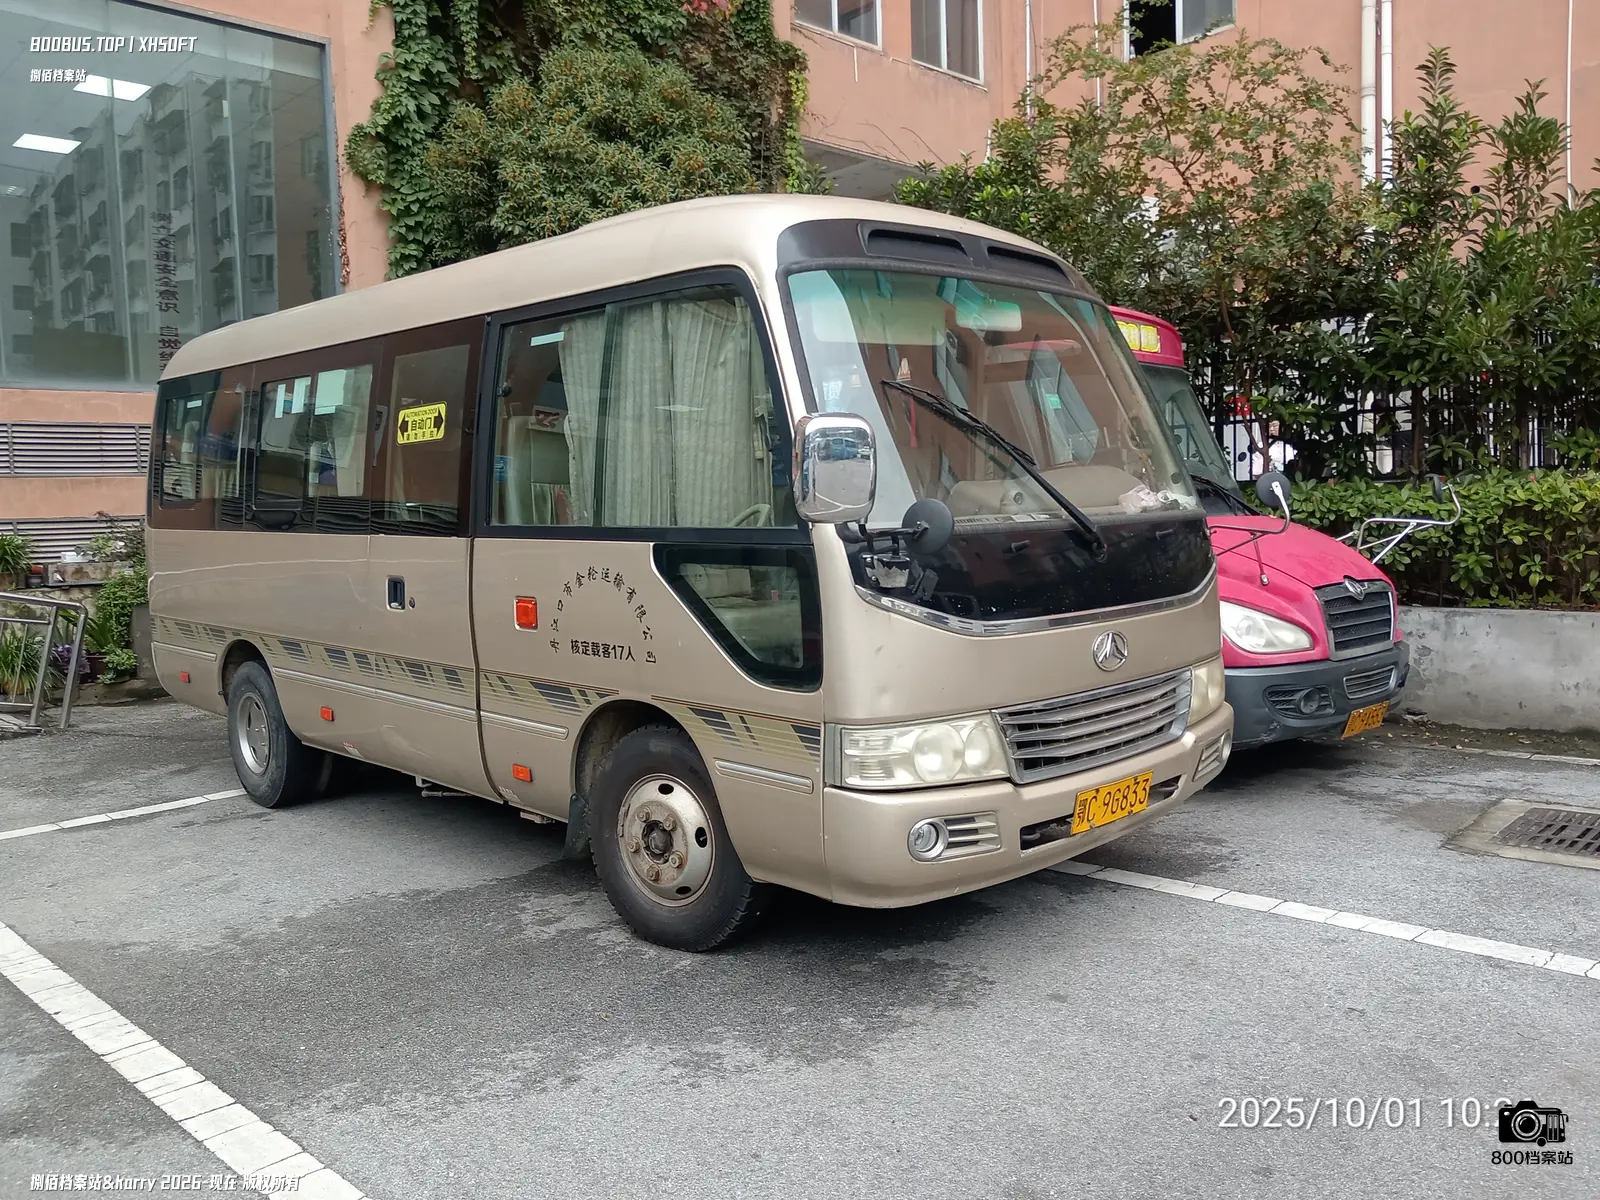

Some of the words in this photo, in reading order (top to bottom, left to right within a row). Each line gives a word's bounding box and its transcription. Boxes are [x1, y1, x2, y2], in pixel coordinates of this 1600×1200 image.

[411, 417, 432, 431] 自动门
[570, 639, 636, 662] 核定载客17人
